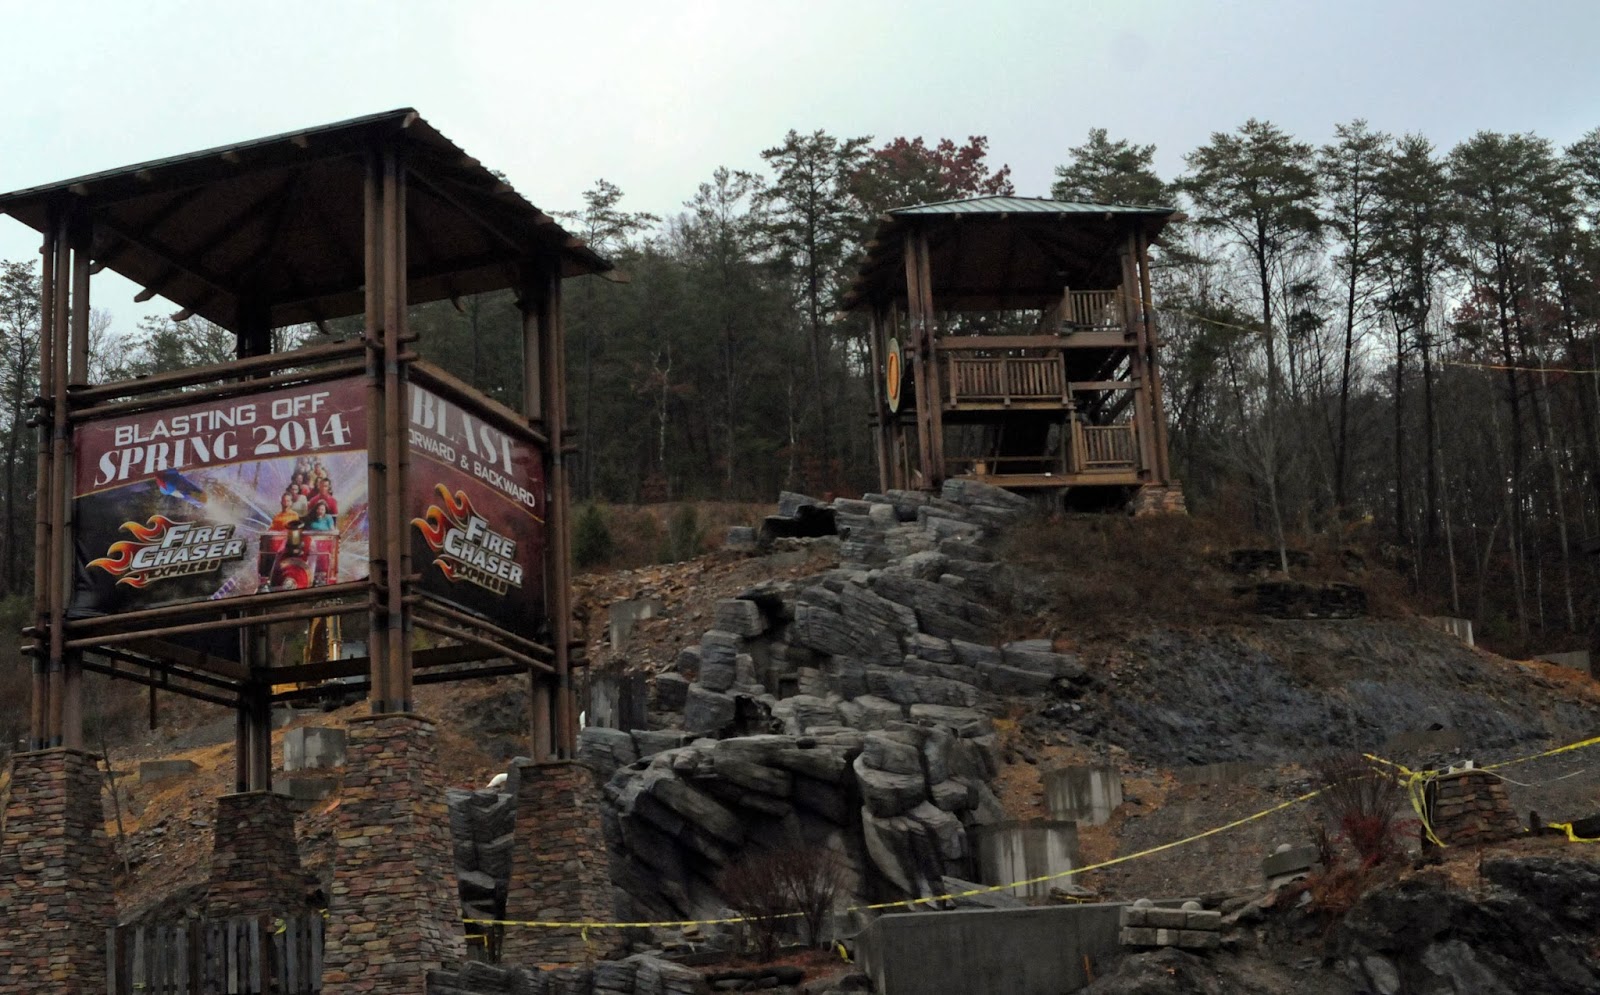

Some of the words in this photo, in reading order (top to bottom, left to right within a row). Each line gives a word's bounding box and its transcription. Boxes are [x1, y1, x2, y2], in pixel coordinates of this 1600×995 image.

[115, 404, 256, 447] BLASTING
[272, 391, 330, 421] OFF
[408, 385, 514, 475] BLAST
[94, 430, 239, 487] SPRING
[252, 412, 352, 456] 2014
[408, 428, 456, 462] ORWARD
[460, 454, 470, 471] &
[473, 461, 536, 508] BACKWARD
[131, 540, 243, 569] CHASER
[161, 524, 231, 549] FIRE
[444, 528, 523, 584] CHASER
[464, 515, 515, 559] FIRE
[147, 559, 220, 579] EXPRESS
